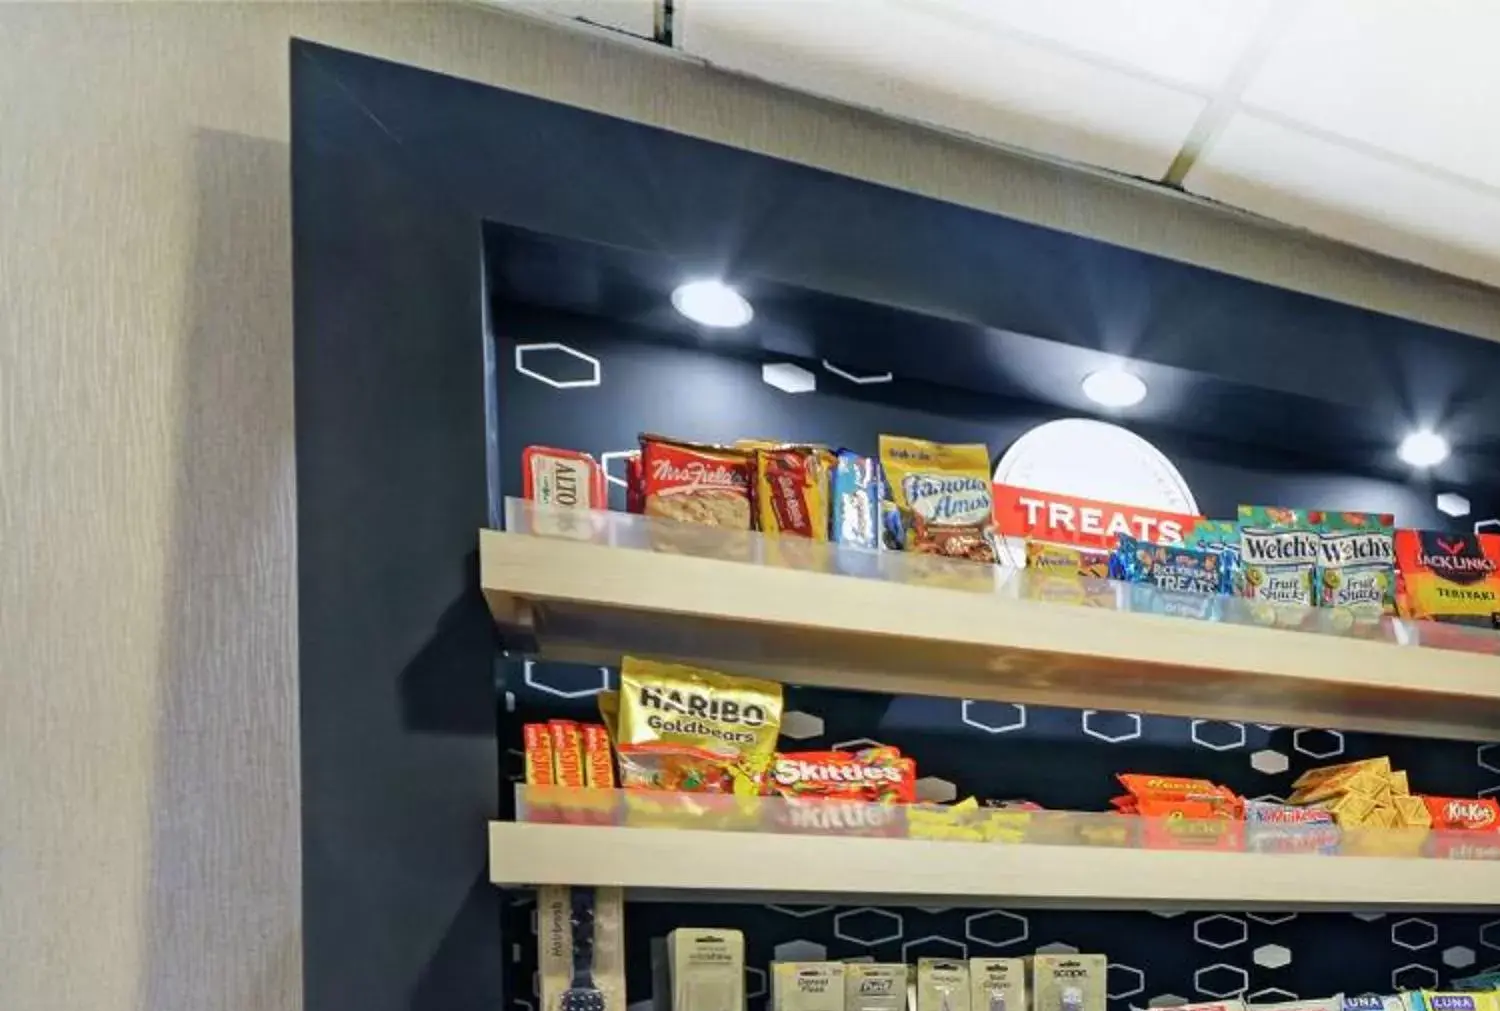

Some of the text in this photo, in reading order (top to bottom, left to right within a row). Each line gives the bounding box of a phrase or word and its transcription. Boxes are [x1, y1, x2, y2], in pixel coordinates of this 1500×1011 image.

[908, 473, 988, 502] Famous
[931, 496, 990, 520] Amos
[1019, 496, 1185, 549] TREATS
[1247, 535, 1318, 560] Welch's
[1322, 537, 1391, 562] Welch's
[1155, 575, 1216, 594] TREATS
[1268, 577, 1299, 590] Fruit
[1347, 577, 1375, 590] Fruit
[1435, 587, 1496, 601] TERIYAKI
[639, 686, 765, 727] HARIBO
[647, 714, 756, 744] Goldbears
[774, 760, 903, 784] Skittles
[1346, 996, 1381, 1008] UNA
[1433, 995, 1473, 1009] LUNA
